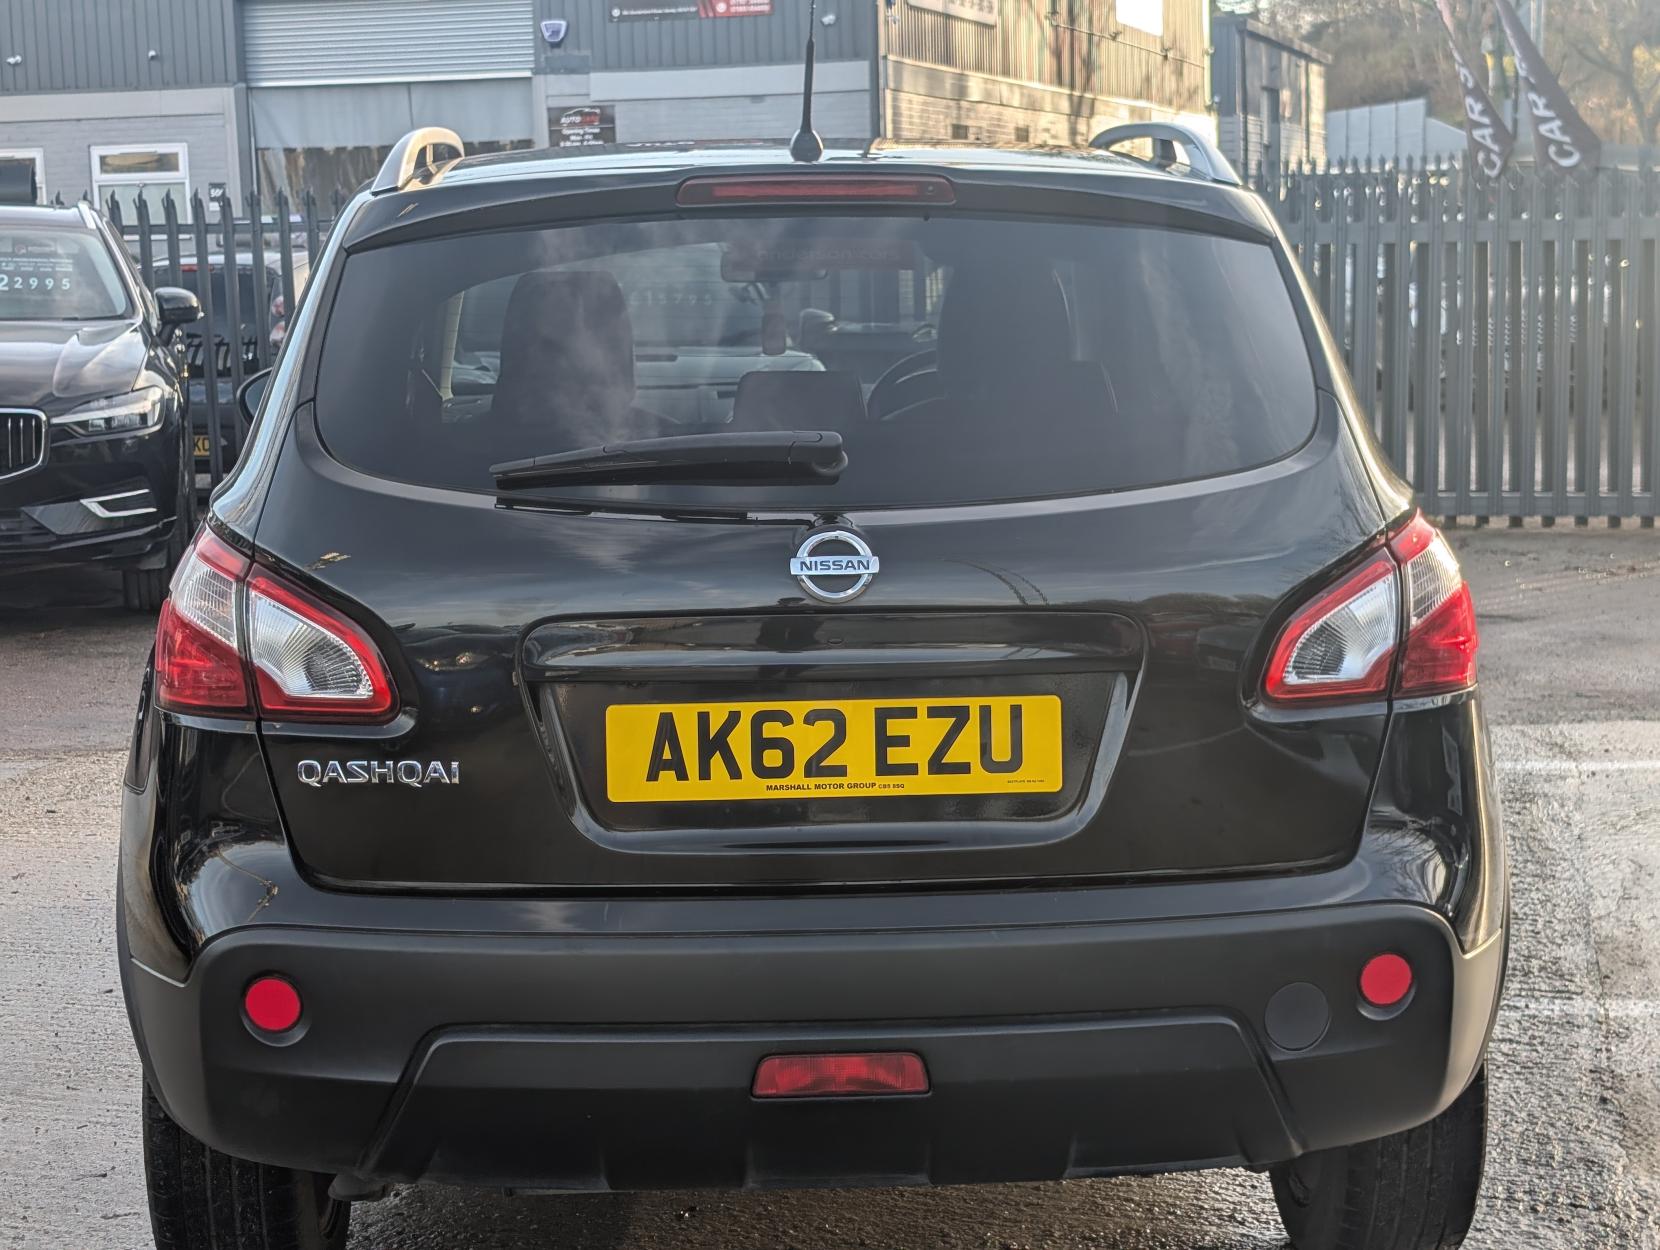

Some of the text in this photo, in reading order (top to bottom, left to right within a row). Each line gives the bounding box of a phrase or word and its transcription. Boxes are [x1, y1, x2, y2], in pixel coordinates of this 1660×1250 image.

[1528, 91, 1581, 167] CAR
[0, 274, 71, 291] 22995
[800, 559, 870, 571] NISSAN
[645, 703, 1024, 782] AK62 EZU
[297, 759, 460, 788] QASHQAI
[765, 783, 812, 791] MARSHALL
